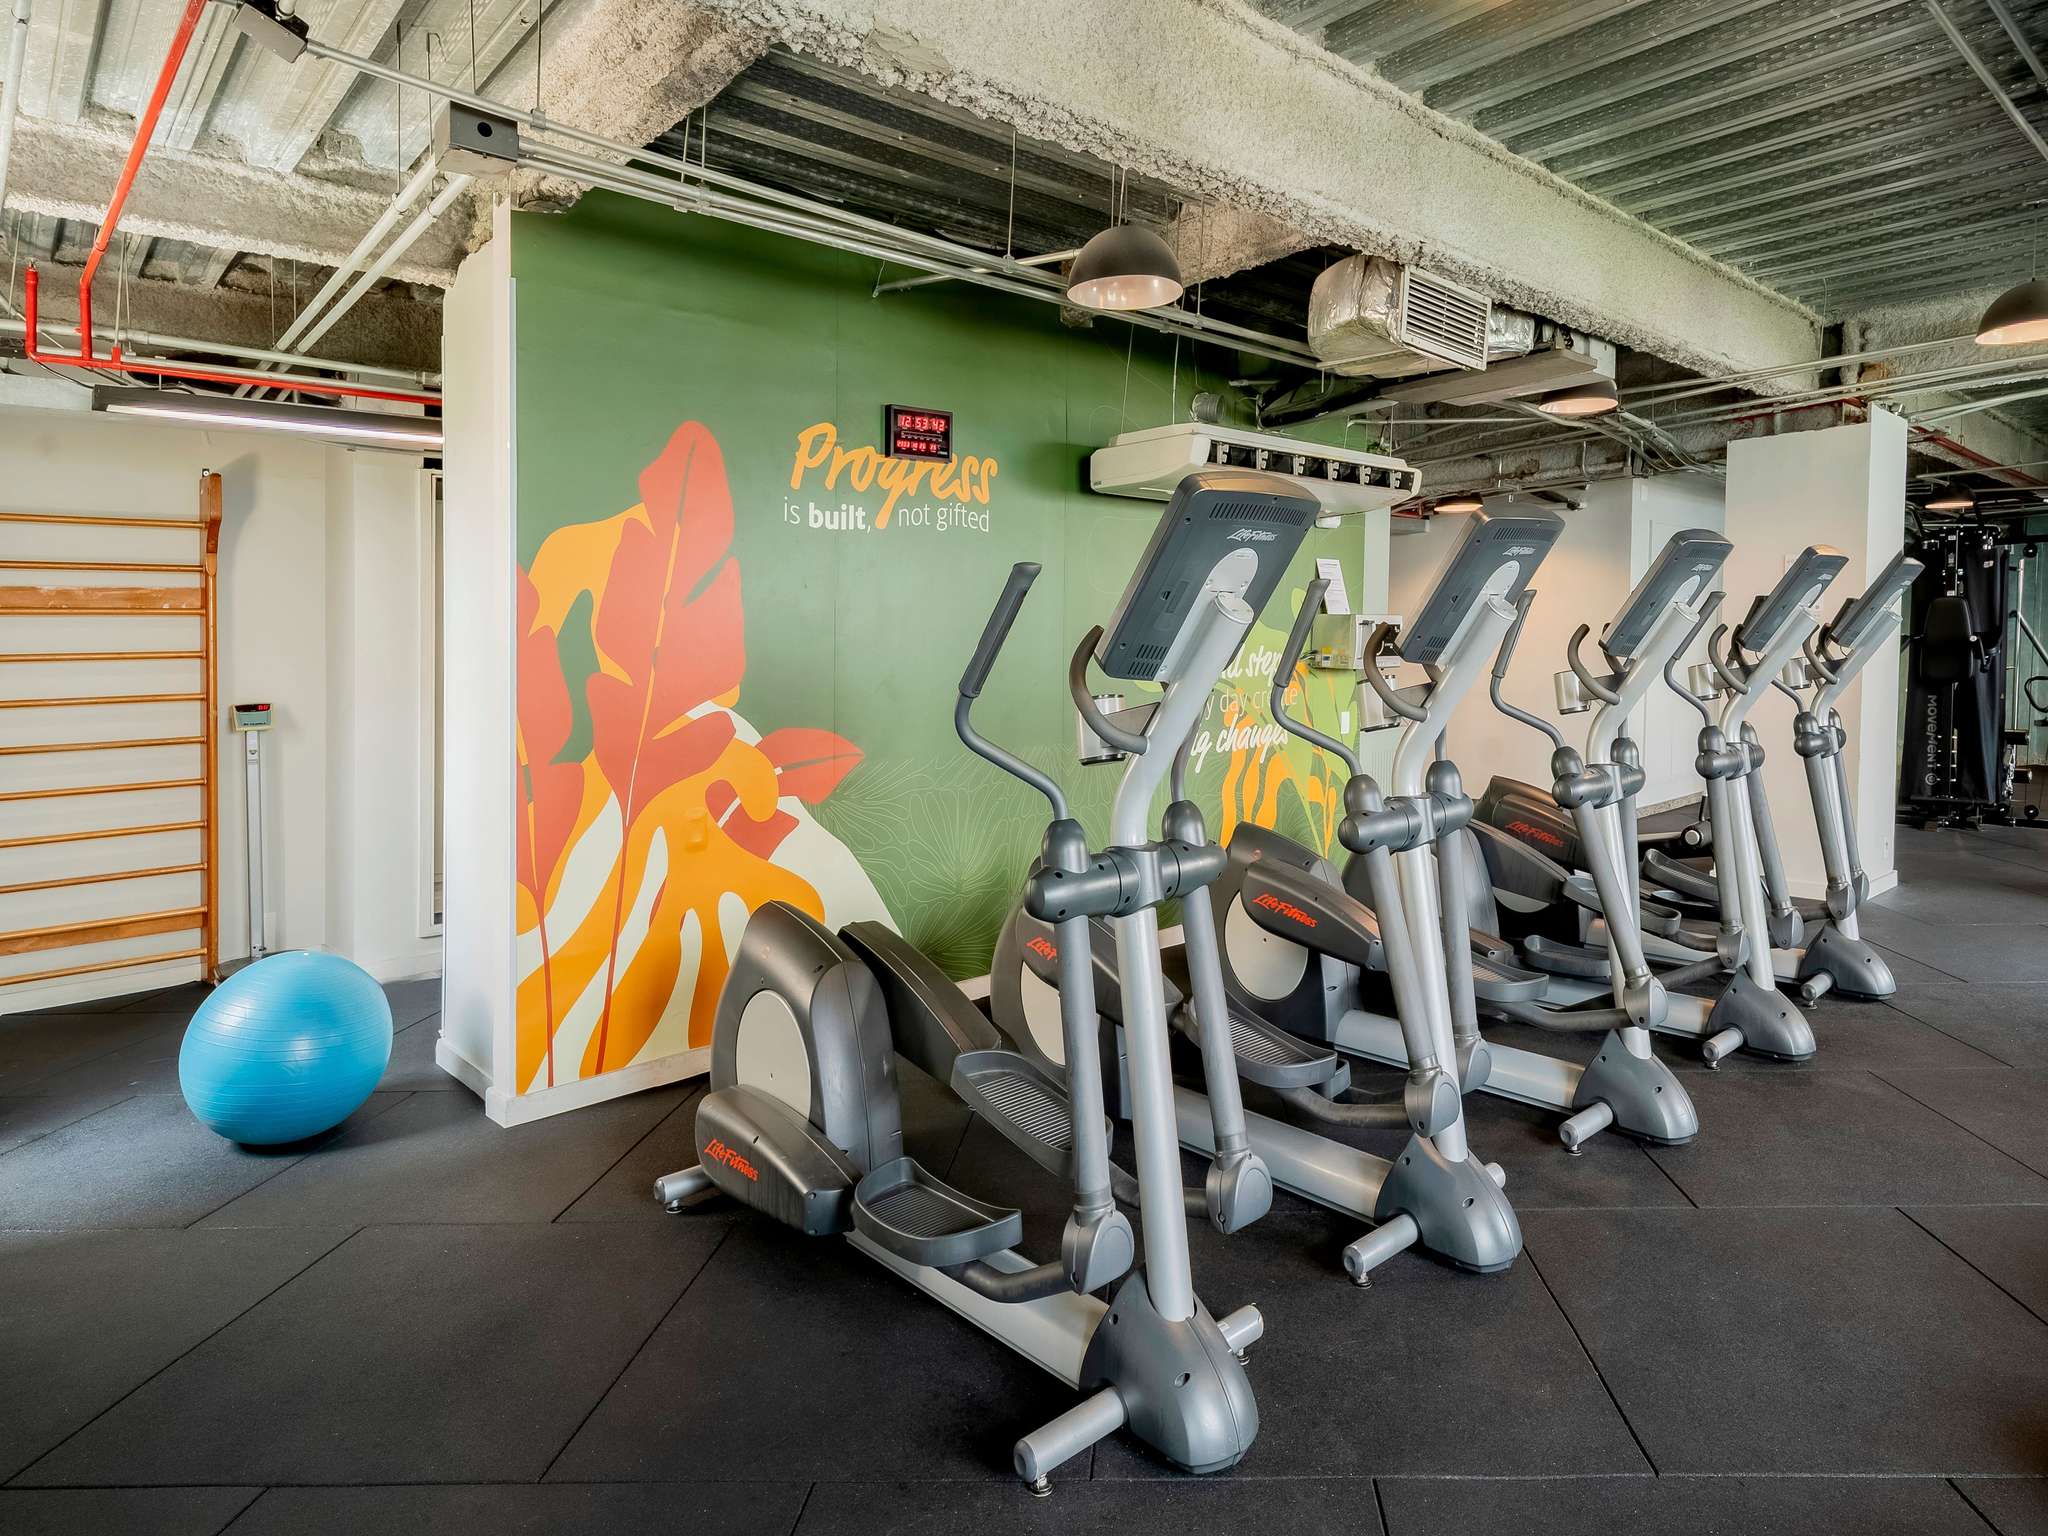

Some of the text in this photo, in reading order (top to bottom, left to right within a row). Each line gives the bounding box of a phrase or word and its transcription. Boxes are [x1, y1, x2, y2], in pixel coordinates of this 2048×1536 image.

[790, 422, 998, 529] Progress
[783, 496, 990, 533] is built, not gifted
[1219, 687, 1249, 716] day
[1215, 713, 1289, 764] changes
